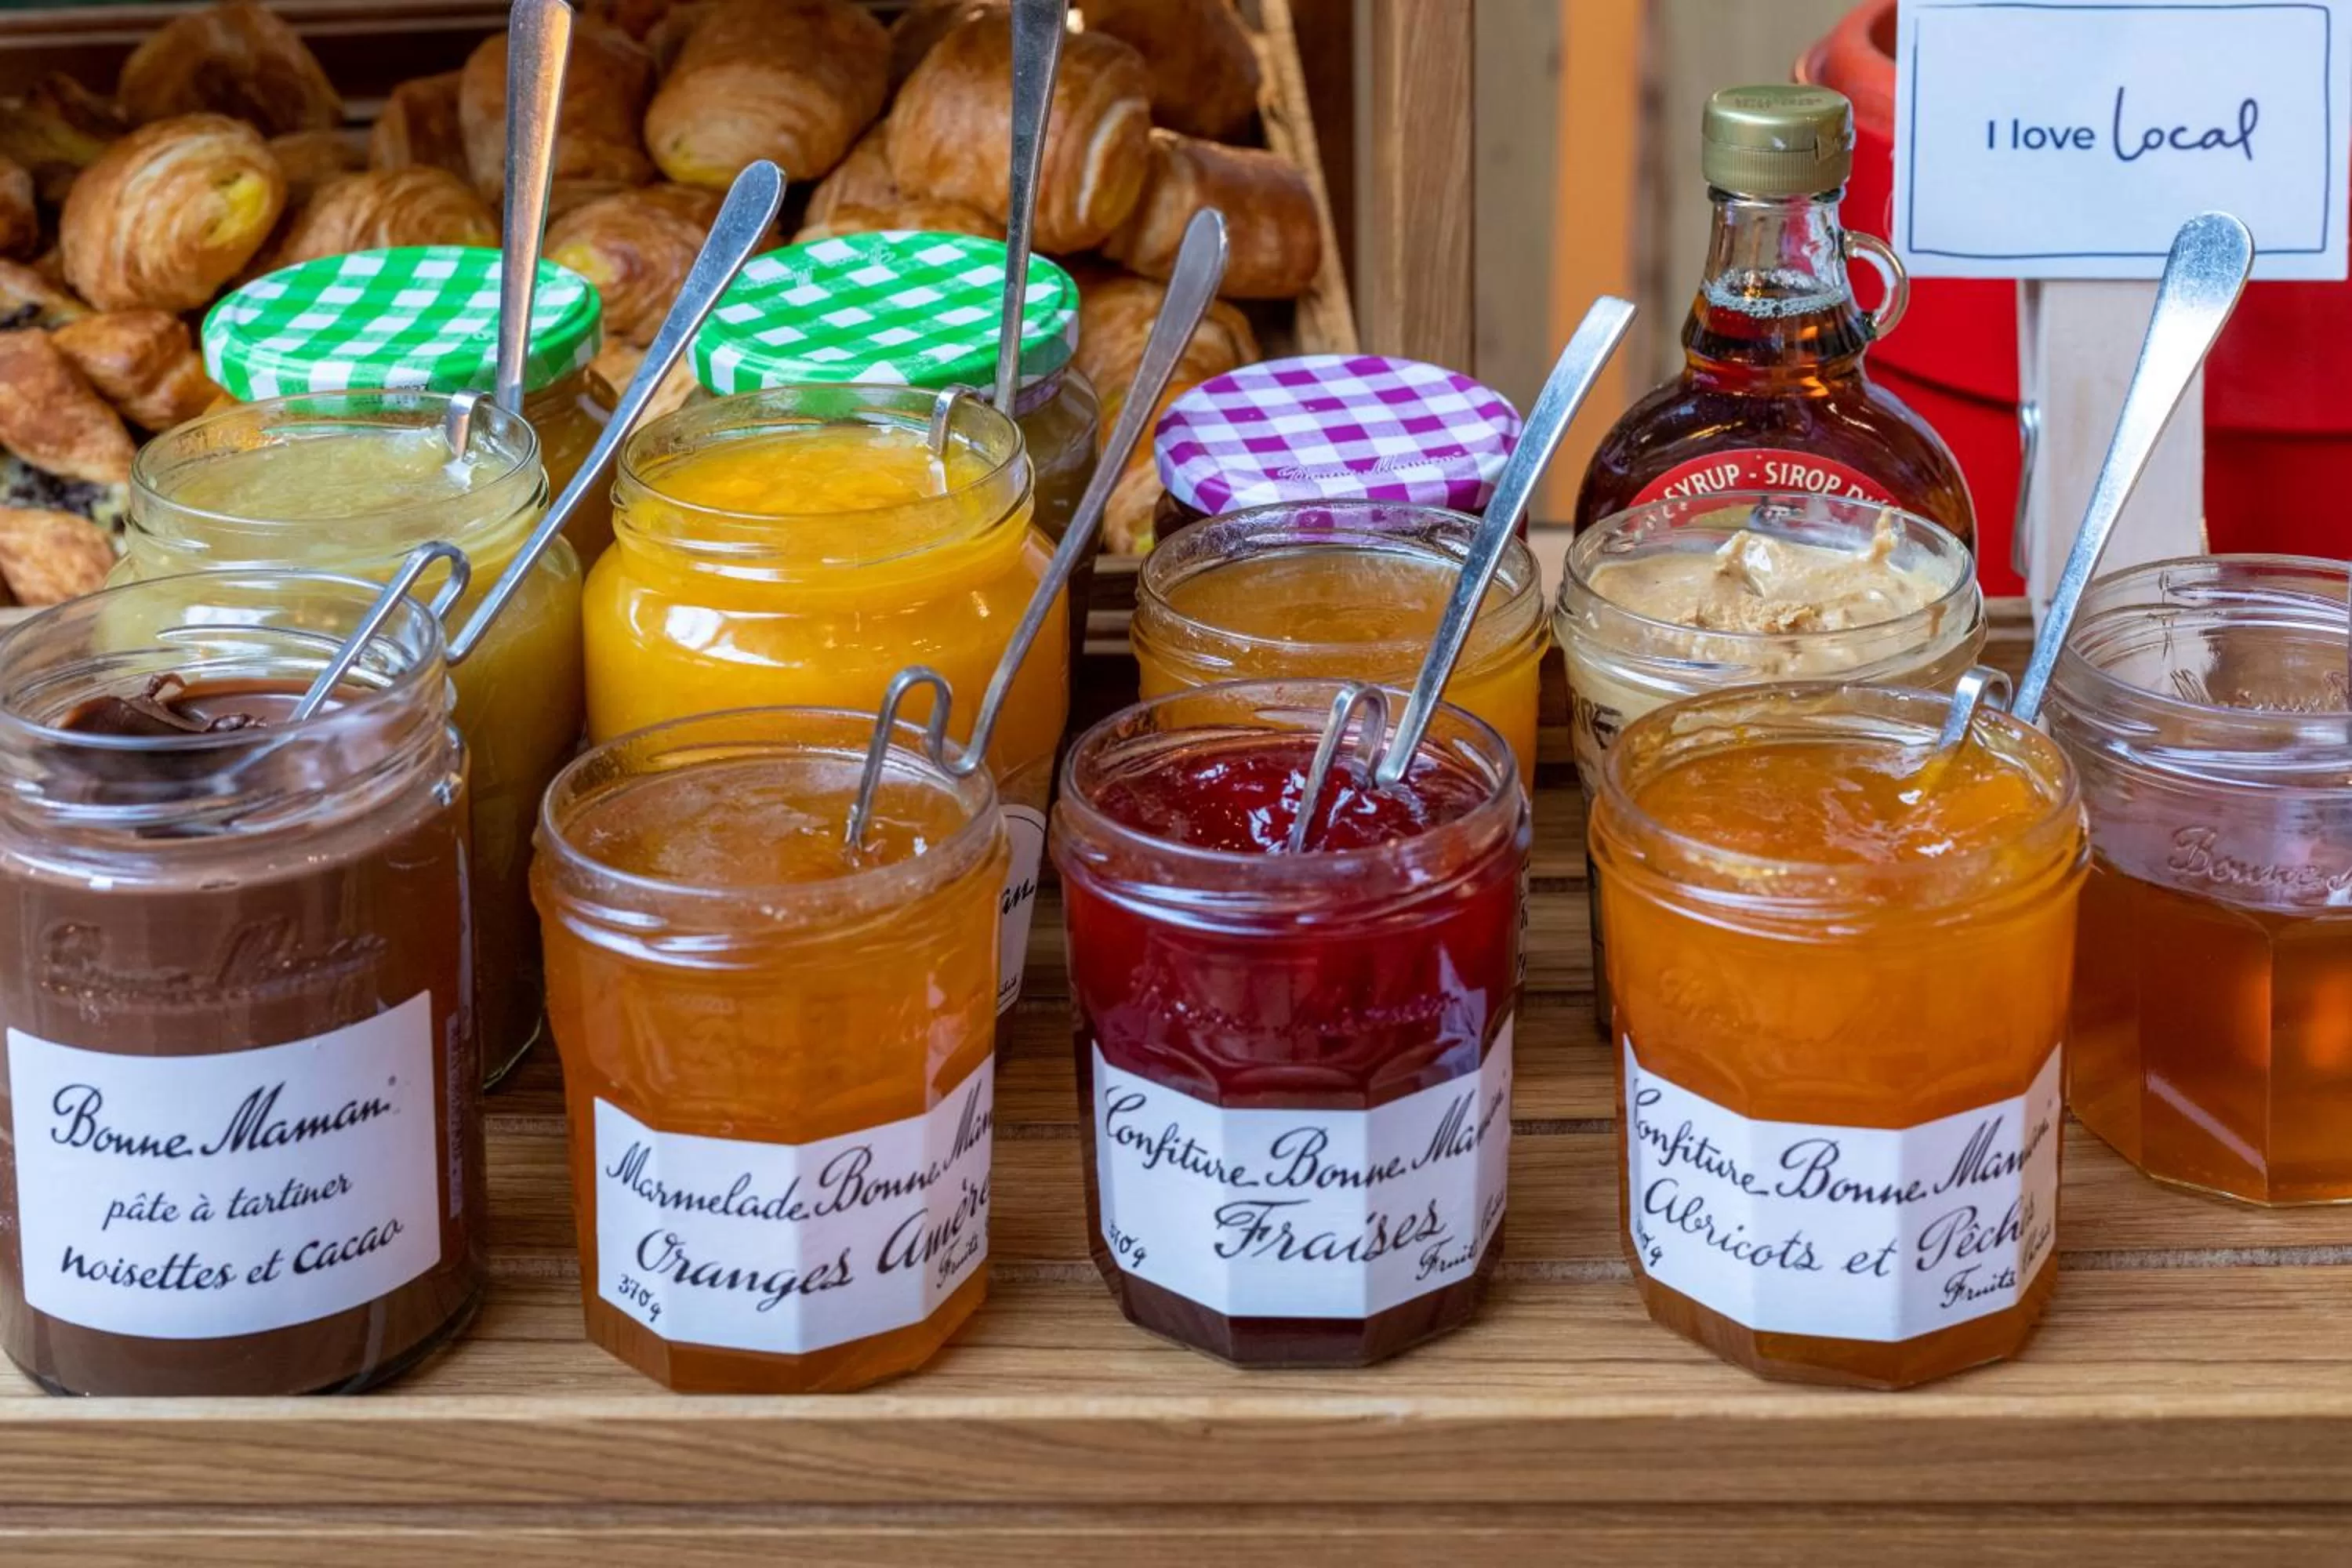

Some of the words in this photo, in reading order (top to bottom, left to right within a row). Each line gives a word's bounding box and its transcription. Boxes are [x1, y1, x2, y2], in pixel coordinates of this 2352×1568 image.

[1987, 120, 1995, 150] I
[2011, 118, 2096, 151] love
[1664, 463, 1740, 500] SYRUP
[1764, 461, 1842, 495] SIROP
[51, 1083, 194, 1158] Bonne
[200, 1080, 391, 1156] Maman
[1105, 1085, 1258, 1188] Confiture
[1266, 1126, 1407, 1189] Bonne
[1634, 1078, 1769, 1196] Confiture
[1776, 1138, 1926, 1205] Bonne
[102, 1192, 181, 1230] pâte
[190, 1192, 216, 1222] à
[226, 1173, 353, 1219] tartiner
[606, 1142, 811, 1221] Marmelade
[814, 1143, 942, 1215] Bonne
[1214, 1198, 1449, 1263] Fraises
[1841, 1236, 1901, 1277] et
[246, 1248, 285, 1285] et
[636, 1228, 857, 1312] Oranges
[1939, 1263, 2016, 1309] Fruits
